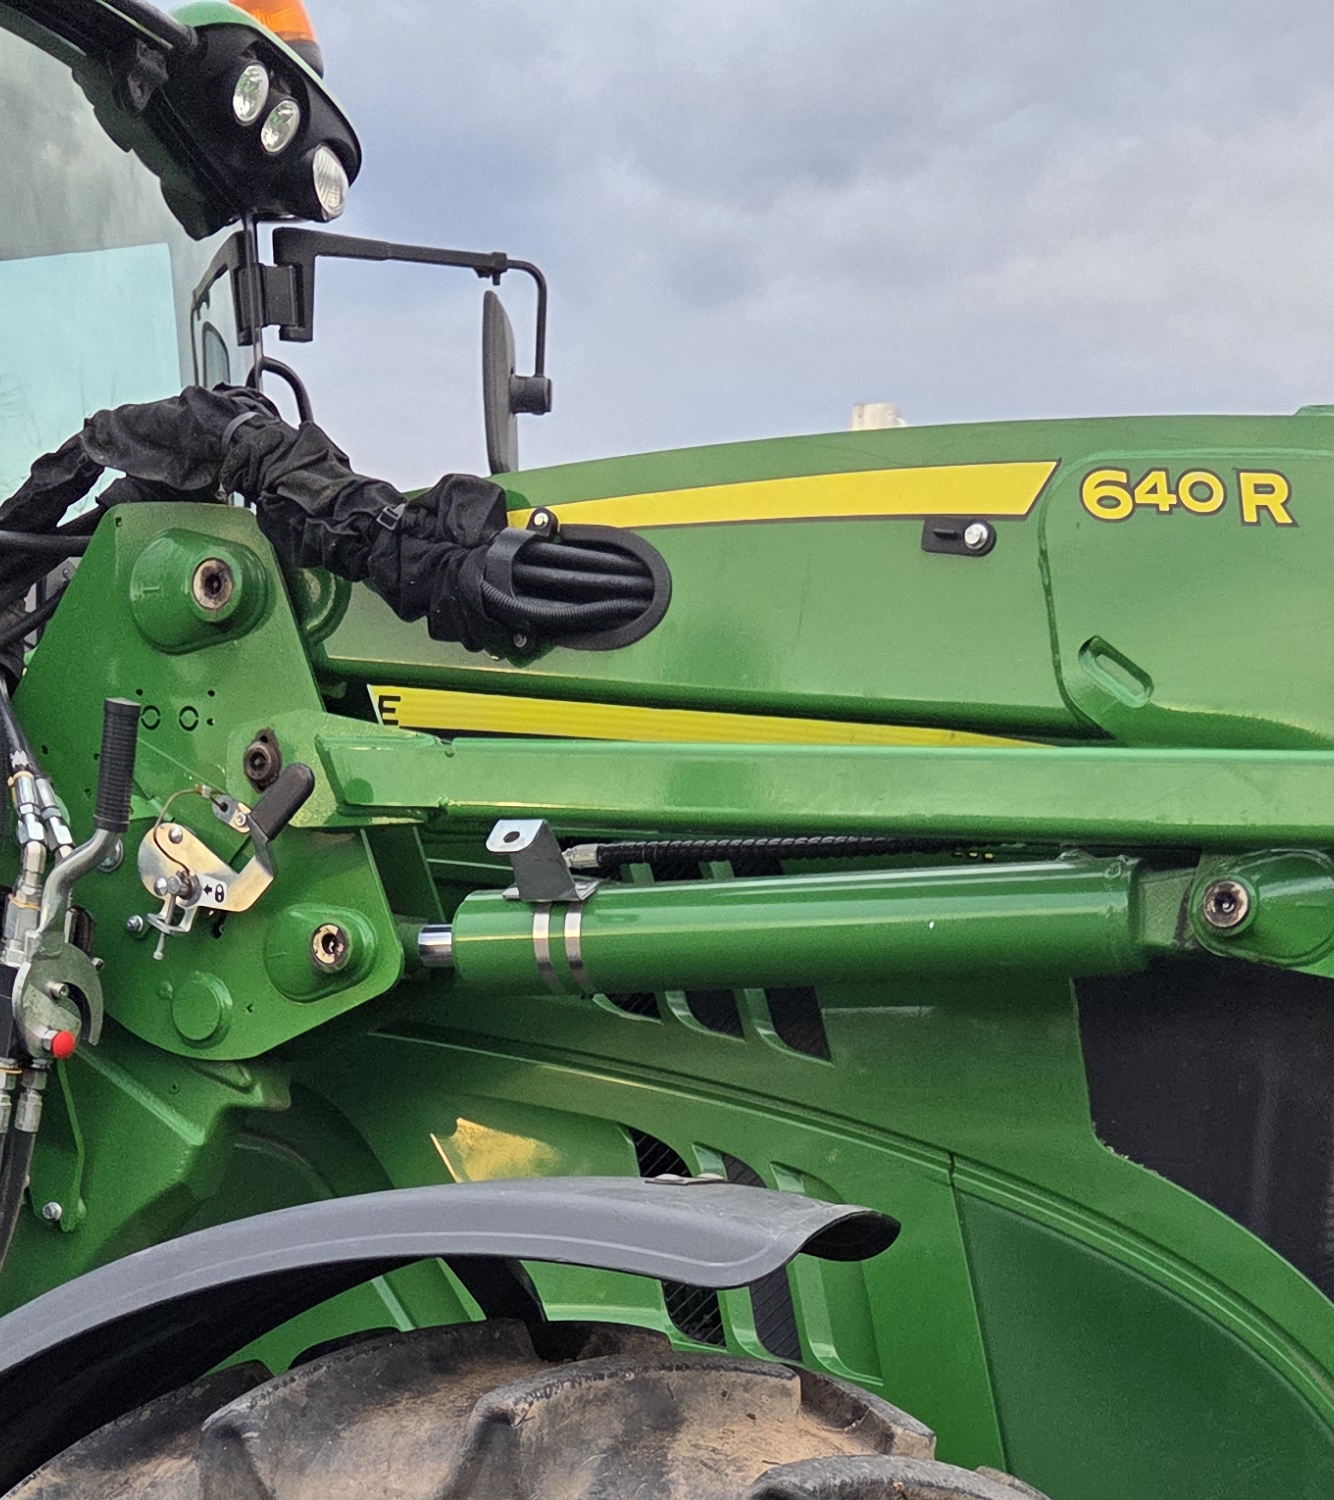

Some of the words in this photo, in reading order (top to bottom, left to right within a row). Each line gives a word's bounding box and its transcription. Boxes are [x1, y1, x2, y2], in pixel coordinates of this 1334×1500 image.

[1080, 467, 1226, 522] 640
[1238, 470, 1296, 525] R
[378, 695, 401, 726] E
